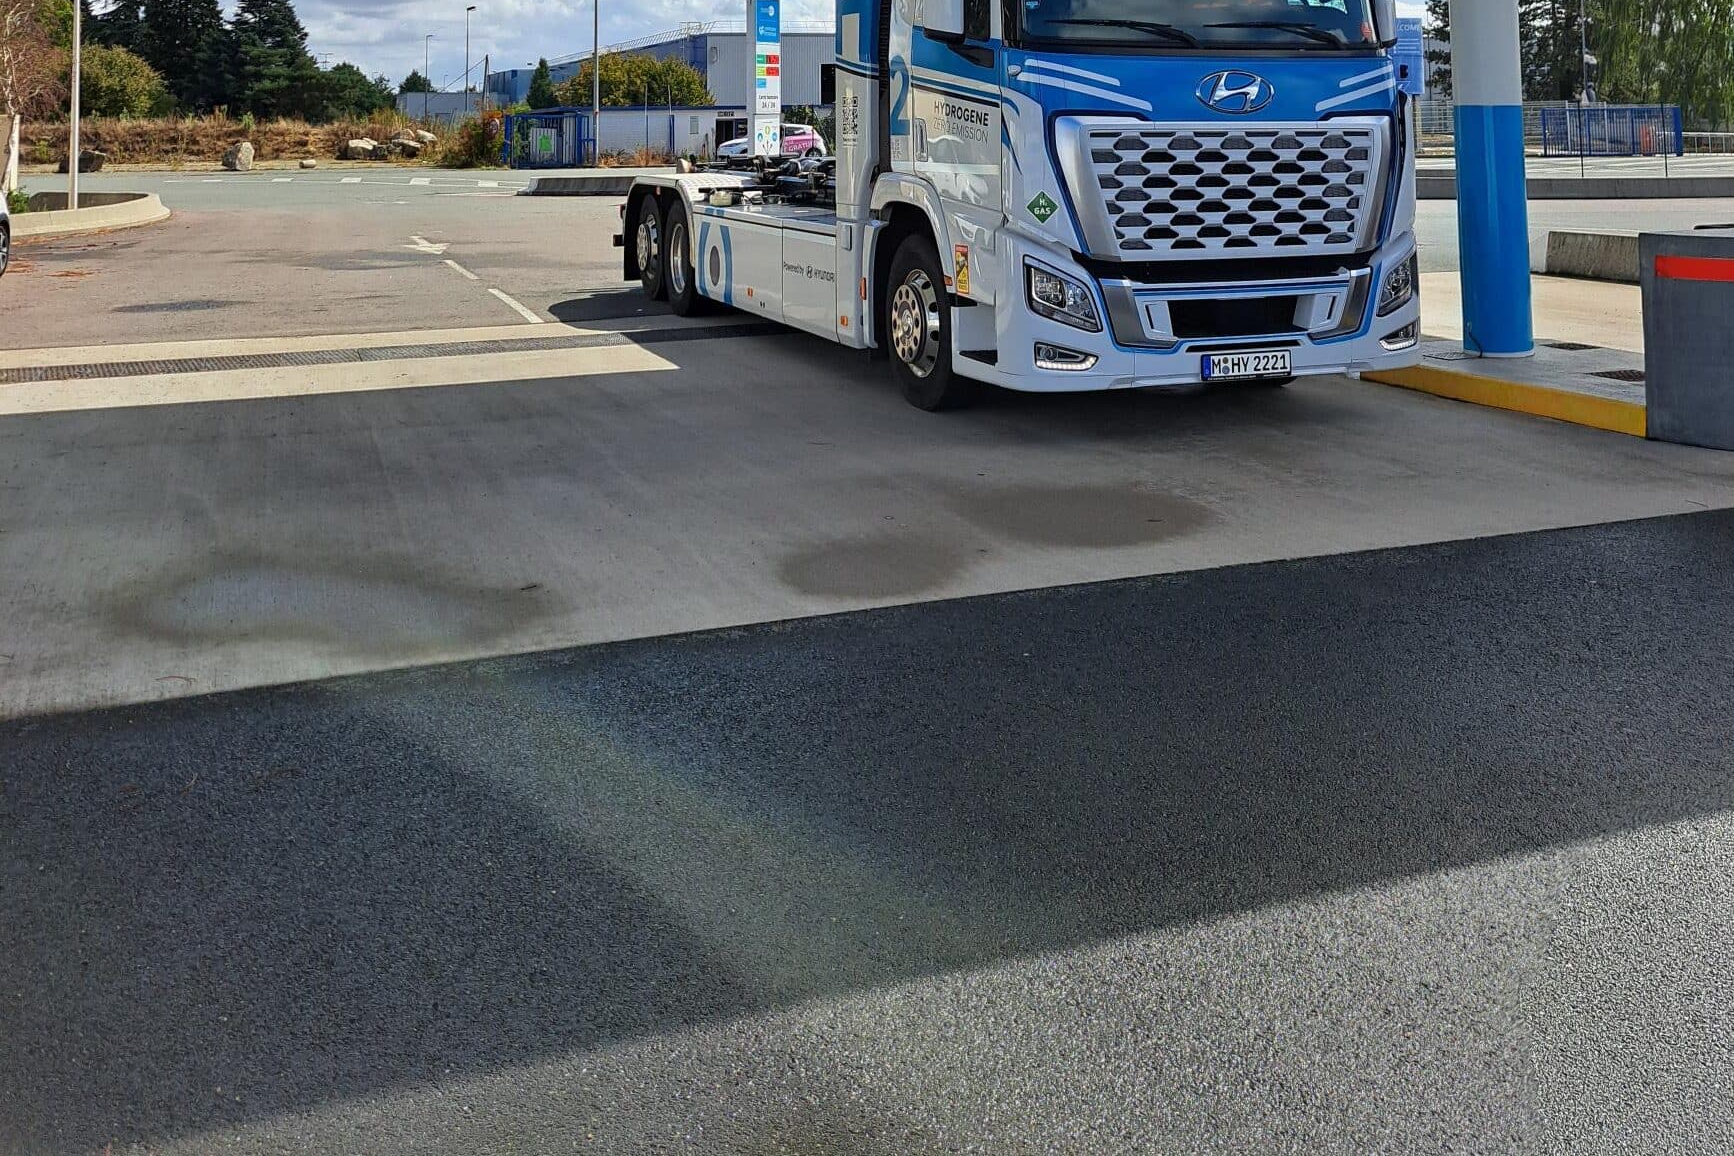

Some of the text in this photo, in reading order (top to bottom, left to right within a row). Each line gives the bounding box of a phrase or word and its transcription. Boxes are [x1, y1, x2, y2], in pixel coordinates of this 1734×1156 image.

[934, 100, 989, 127] HYDROGENE
[951, 122, 989, 145] EMISSION
[1034, 207, 1051, 215] GAS
[1253, 354, 1288, 371] 2221
